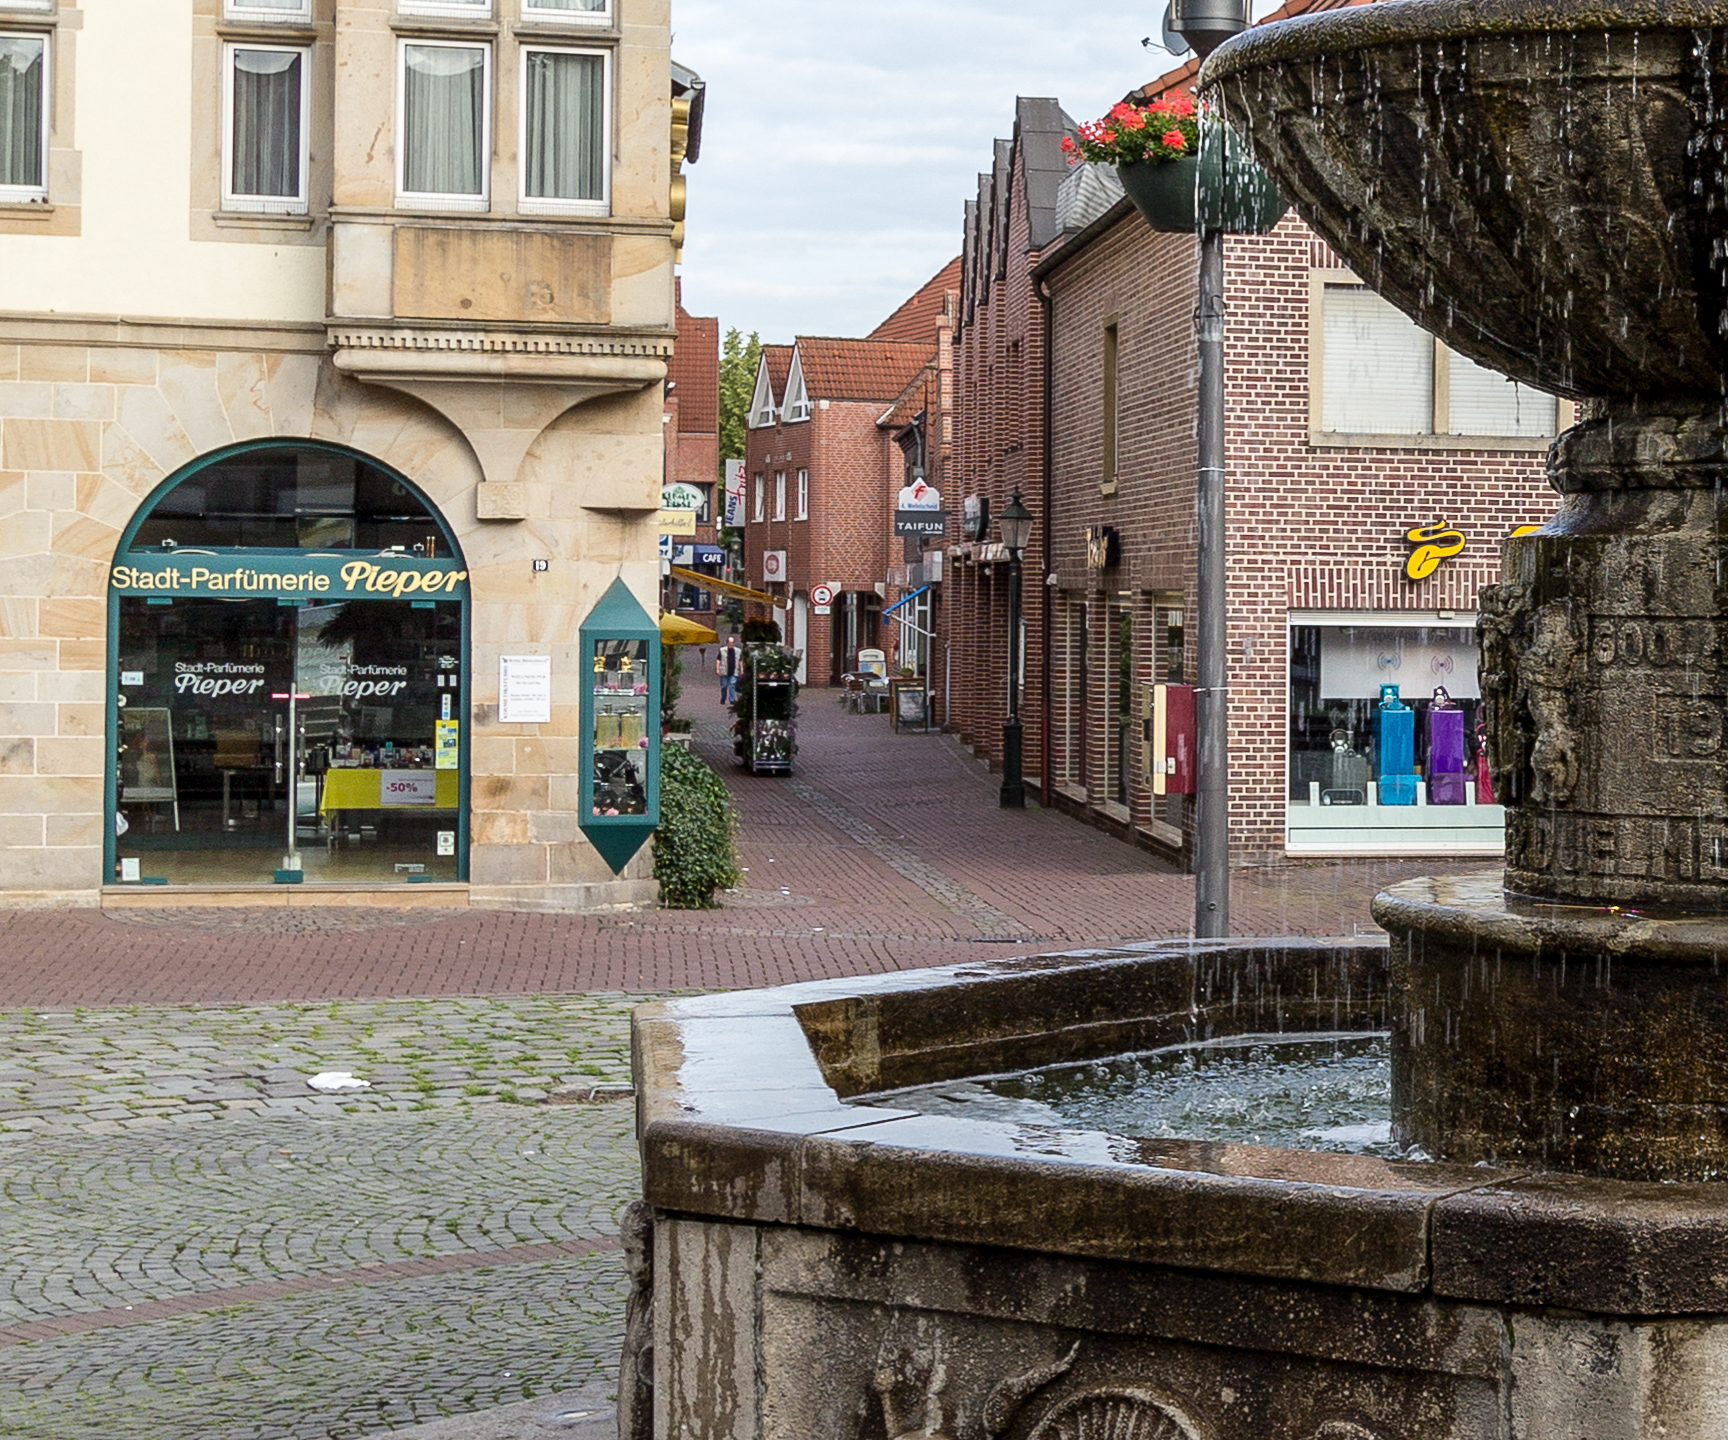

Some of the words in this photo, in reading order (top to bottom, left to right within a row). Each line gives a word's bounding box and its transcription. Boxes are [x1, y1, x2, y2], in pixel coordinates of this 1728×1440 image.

[725, 495, 738, 526] JEANS
[896, 521, 944, 531] TAIFUN
[535, 560, 547, 571] 19
[111, 566, 331, 592] Stadt-Parfümerie
[340, 561, 468, 598] Pieper
[174, 662, 264, 675] Stadt-Parfümerie
[319, 663, 407, 676] Stadt-Parfümerie
[174, 674, 264, 698] Pieper
[320, 676, 407, 700] Pieper
[386, 782, 418, 793] -50%
